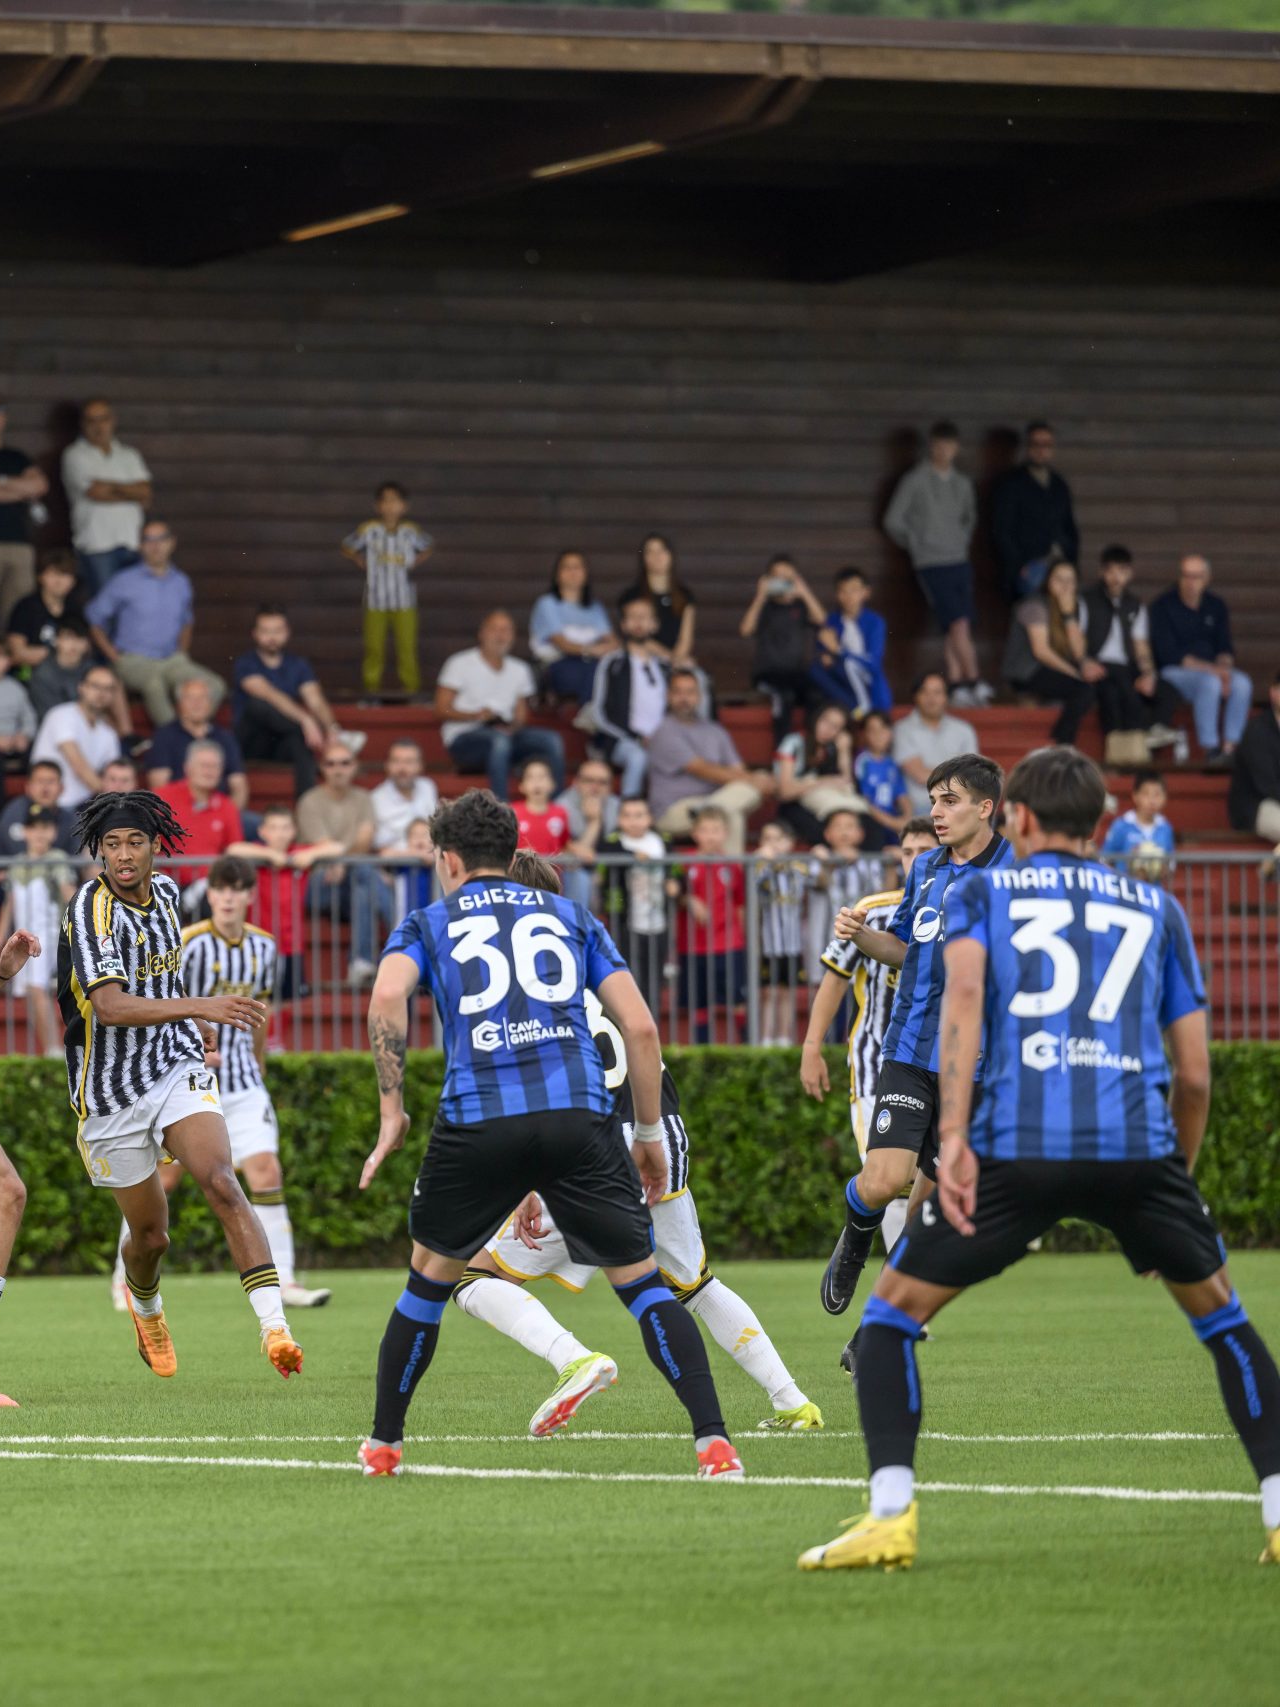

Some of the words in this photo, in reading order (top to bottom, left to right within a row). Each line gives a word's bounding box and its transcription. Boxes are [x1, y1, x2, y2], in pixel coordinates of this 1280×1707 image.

[458, 888, 545, 911] GHEZZI
[991, 866, 1160, 911] MARTINELLI
[100, 960, 122, 970] NOW
[447, 913, 577, 1016] 36
[1008, 898, 1154, 1023] 37
[508, 1018, 543, 1033] CAVA
[509, 1026, 575, 1046] GHISALBA
[1066, 1037, 1109, 1052] CAVA
[1066, 1052, 1143, 1075] GHISALBA
